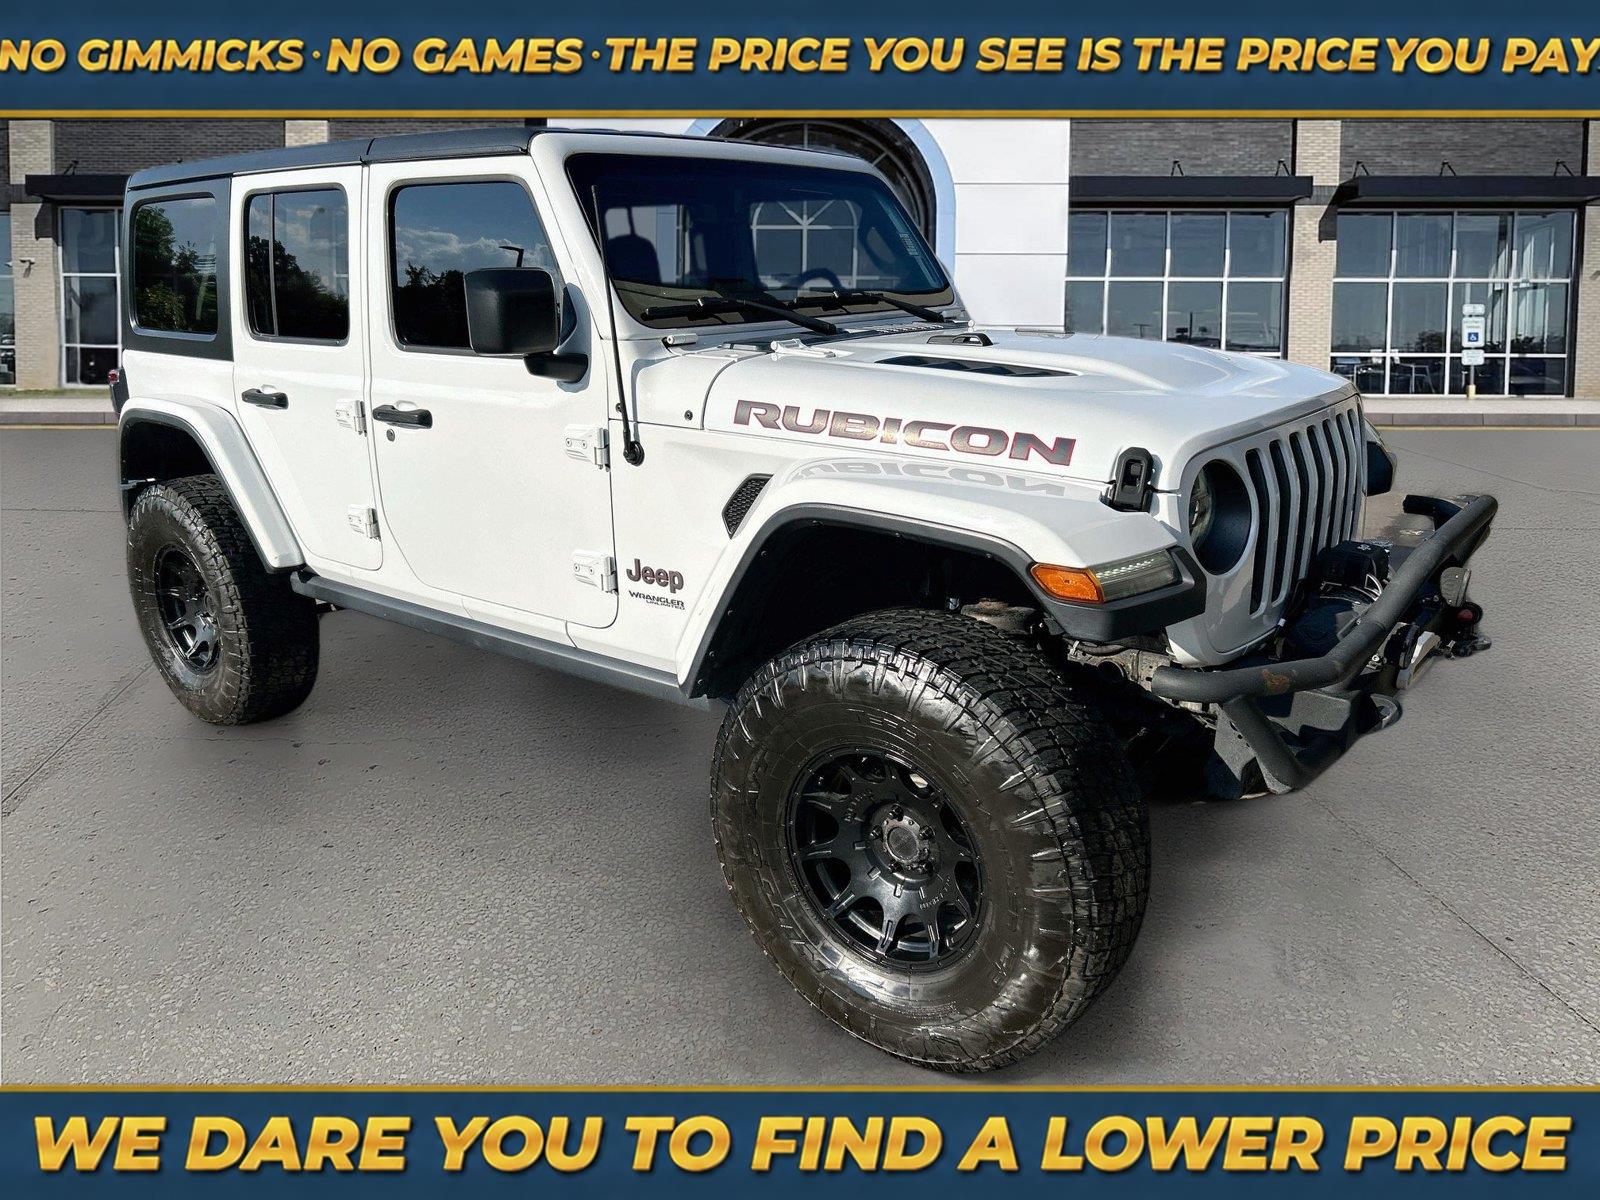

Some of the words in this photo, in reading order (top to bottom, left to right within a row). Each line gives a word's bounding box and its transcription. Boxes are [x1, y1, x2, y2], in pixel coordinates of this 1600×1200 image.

[733, 399, 1077, 467] RUBICON
[626, 558, 684, 594] Jeep
[628, 590, 685, 608] WRANGLER
